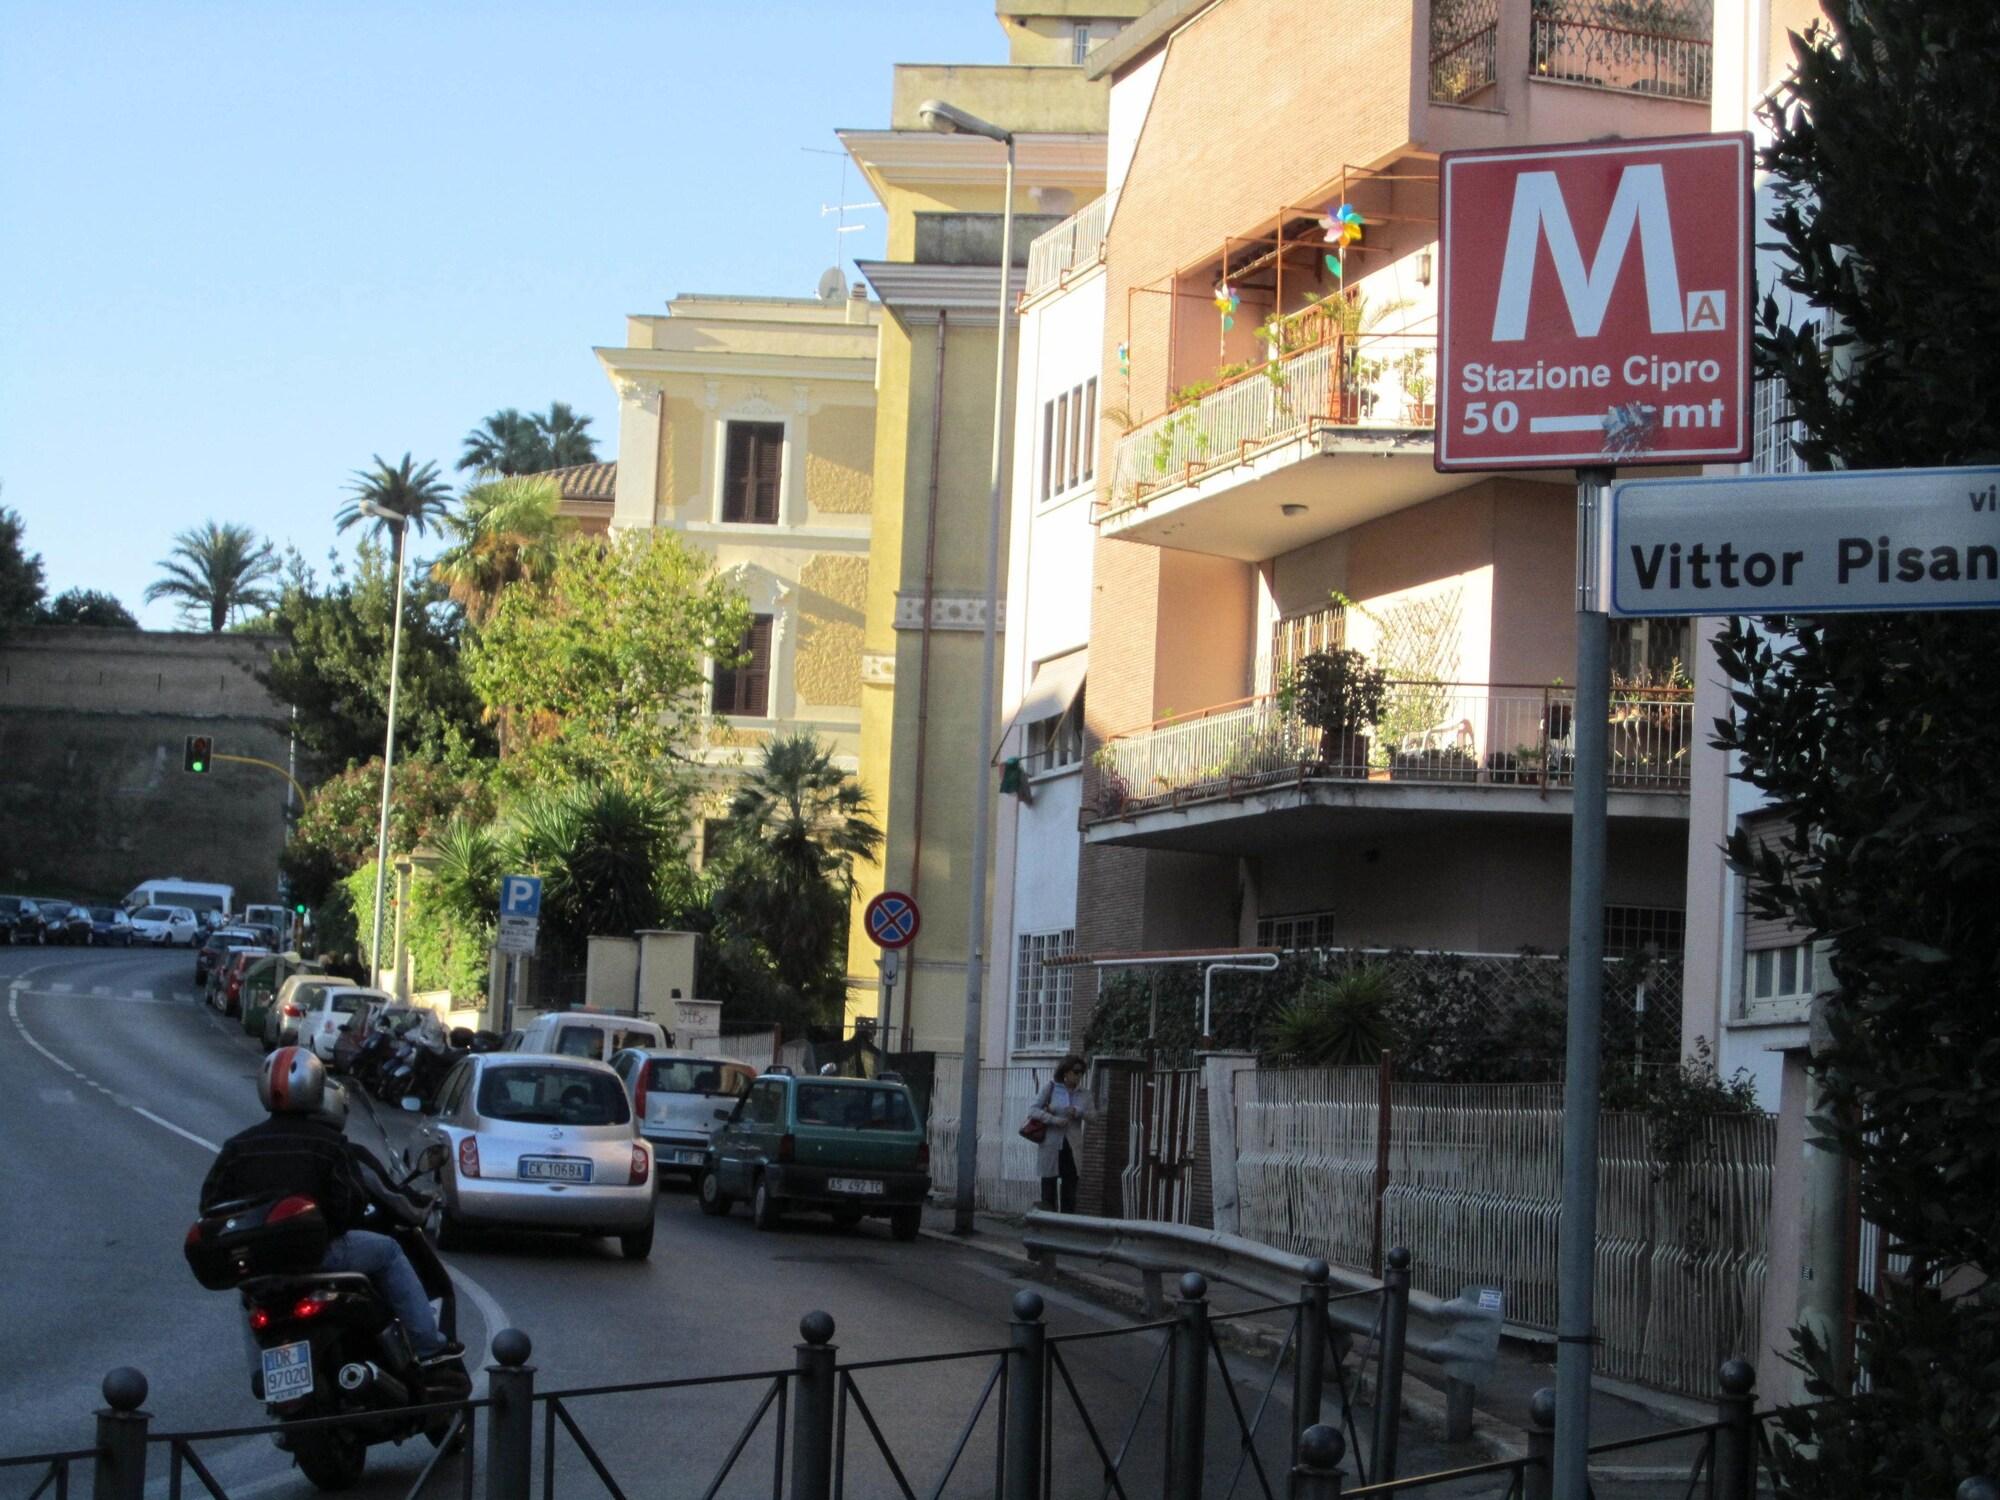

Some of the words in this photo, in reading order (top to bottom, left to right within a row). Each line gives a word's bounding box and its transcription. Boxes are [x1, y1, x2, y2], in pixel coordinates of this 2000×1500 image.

[1492, 164, 1684, 341] M
[1691, 296, 1722, 328] A
[1461, 361, 1611, 393] Stazione
[1622, 354, 1721, 391] Cipro
[1462, 400, 1519, 435] 50
[1663, 397, 1724, 428] mt
[1968, 484, 2000, 512] vi
[1630, 541, 1804, 590] Vittor
[507, 879, 534, 911] P
[268, 1366, 308, 1390] 97020
